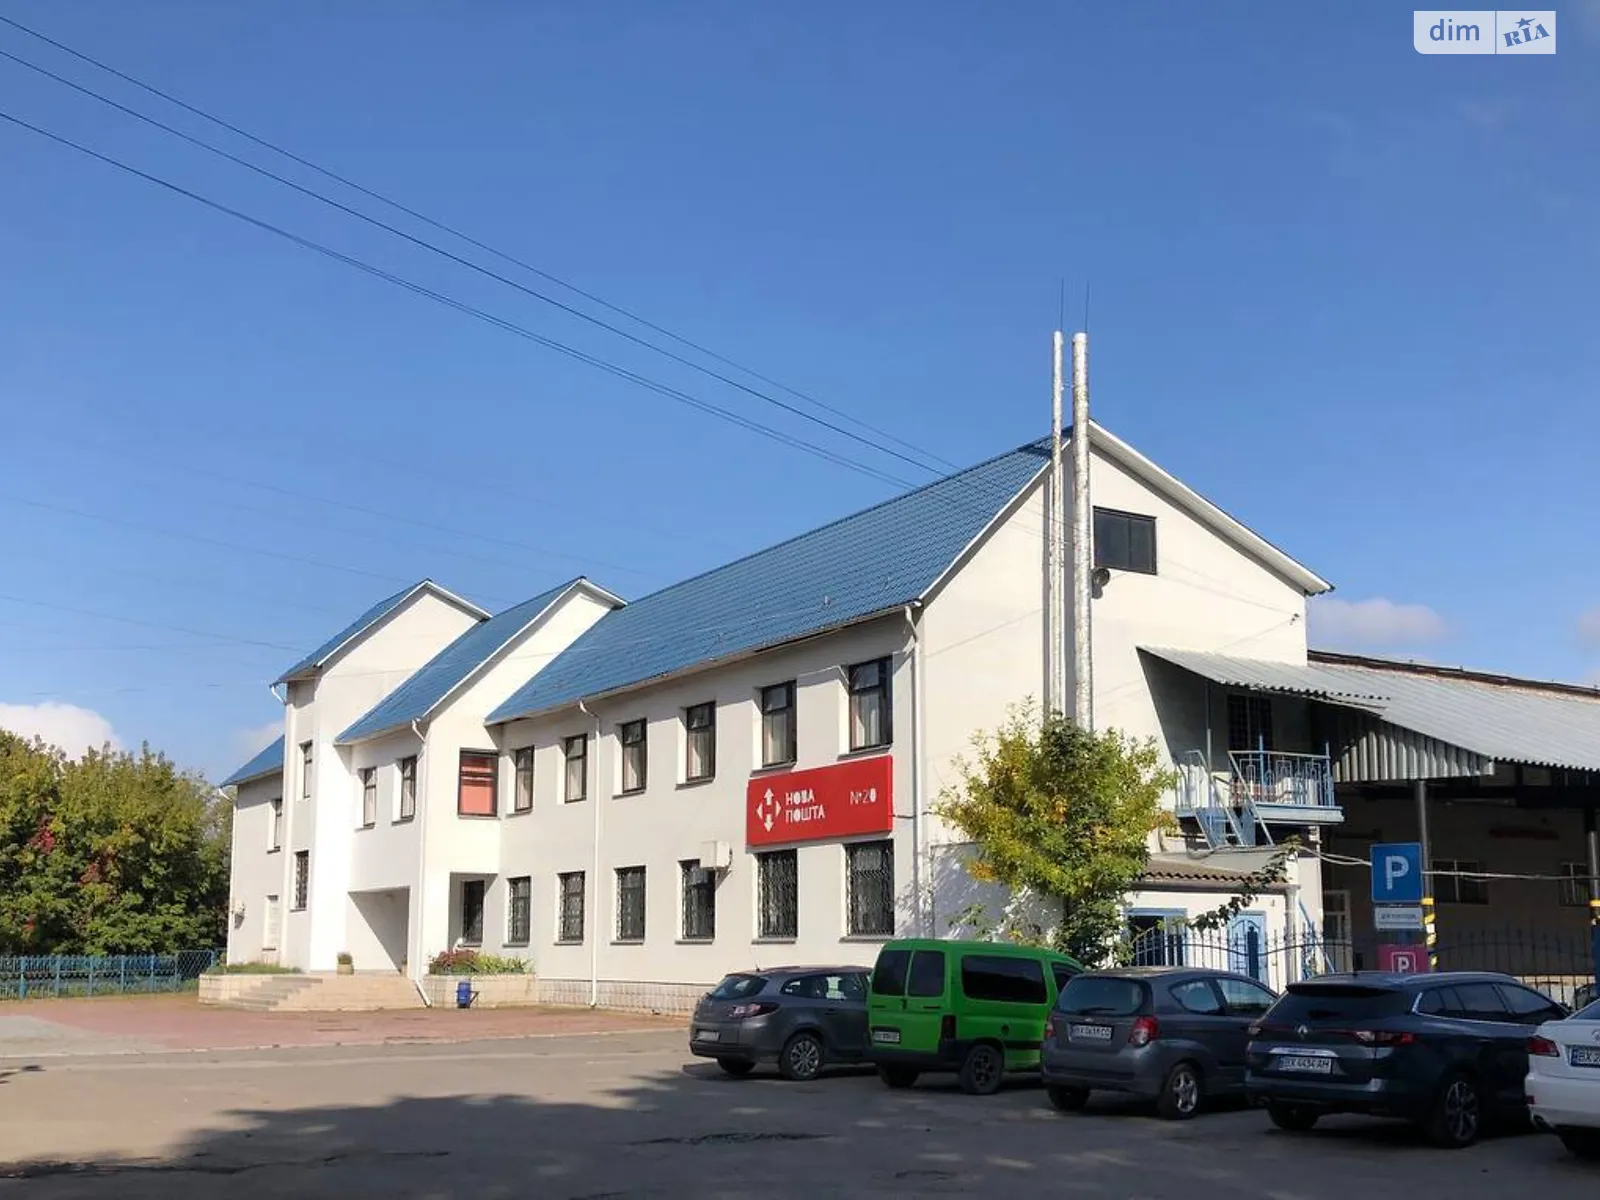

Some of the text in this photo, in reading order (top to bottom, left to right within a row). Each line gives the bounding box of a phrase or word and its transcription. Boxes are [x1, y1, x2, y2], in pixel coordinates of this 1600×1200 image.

[785, 788, 815, 805] НОВА
[785, 804, 826, 823] ПОШТА
[1385, 855, 1410, 890] P
